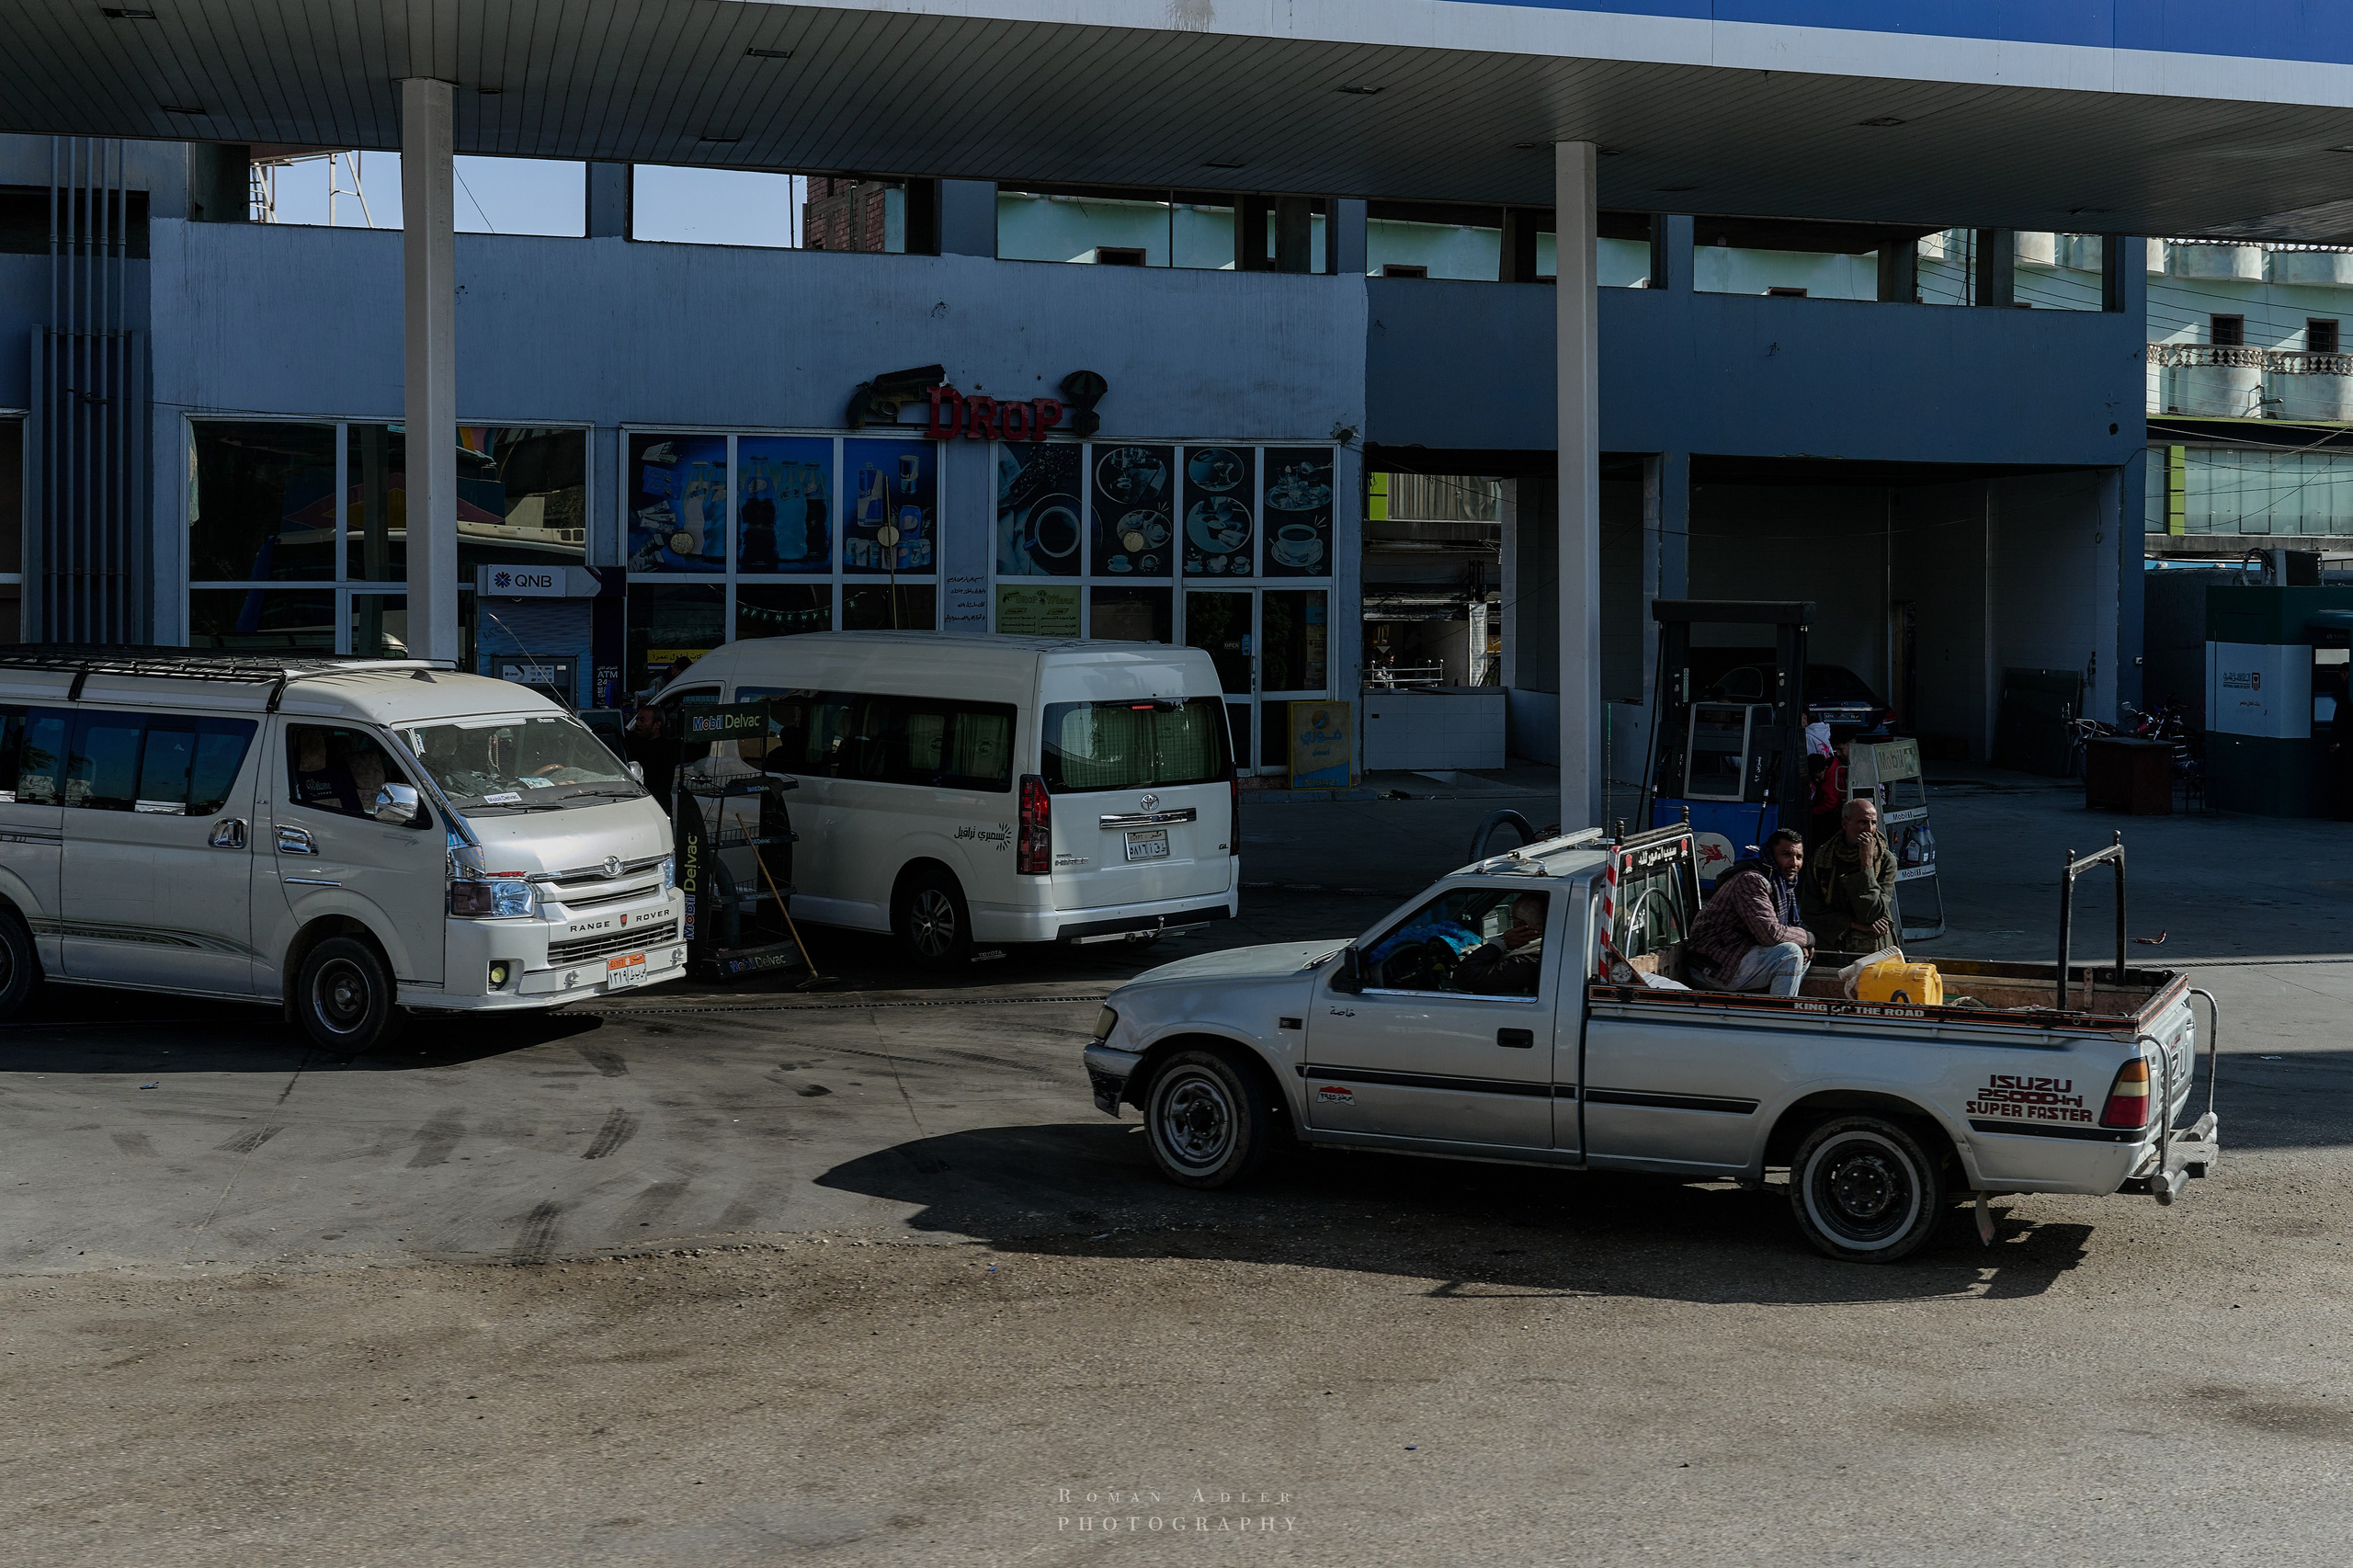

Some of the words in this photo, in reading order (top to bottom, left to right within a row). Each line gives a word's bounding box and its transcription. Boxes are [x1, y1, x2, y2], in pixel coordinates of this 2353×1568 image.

[924, 386, 1063, 441] DROP
[515, 574, 552, 588] QNB
[692, 713, 723, 732] Mobil
[724, 713, 760, 729] Delvac
[1878, 749, 1904, 771] Mobil
[1893, 812, 1908, 821] Mobil
[684, 835, 698, 892] Delvac
[1902, 869, 1917, 879] Mobil
[570, 920, 610, 932] RANGE
[636, 909, 670, 922] ROVER
[684, 894, 696, 939] Mobil
[978, 949, 1003, 958] TOYOTA
[729, 958, 756, 973] Mobil
[755, 954, 785, 968] Delvac
[1794, 1002, 1828, 1012] KING
[1854, 1006, 1881, 1016] THE
[1884, 1008, 1925, 1017] ROAD
[1990, 1074, 2072, 1093] ISUZU
[1966, 1100, 2022, 1117] SUPER
[2028, 1105, 2093, 1122] FASTER
